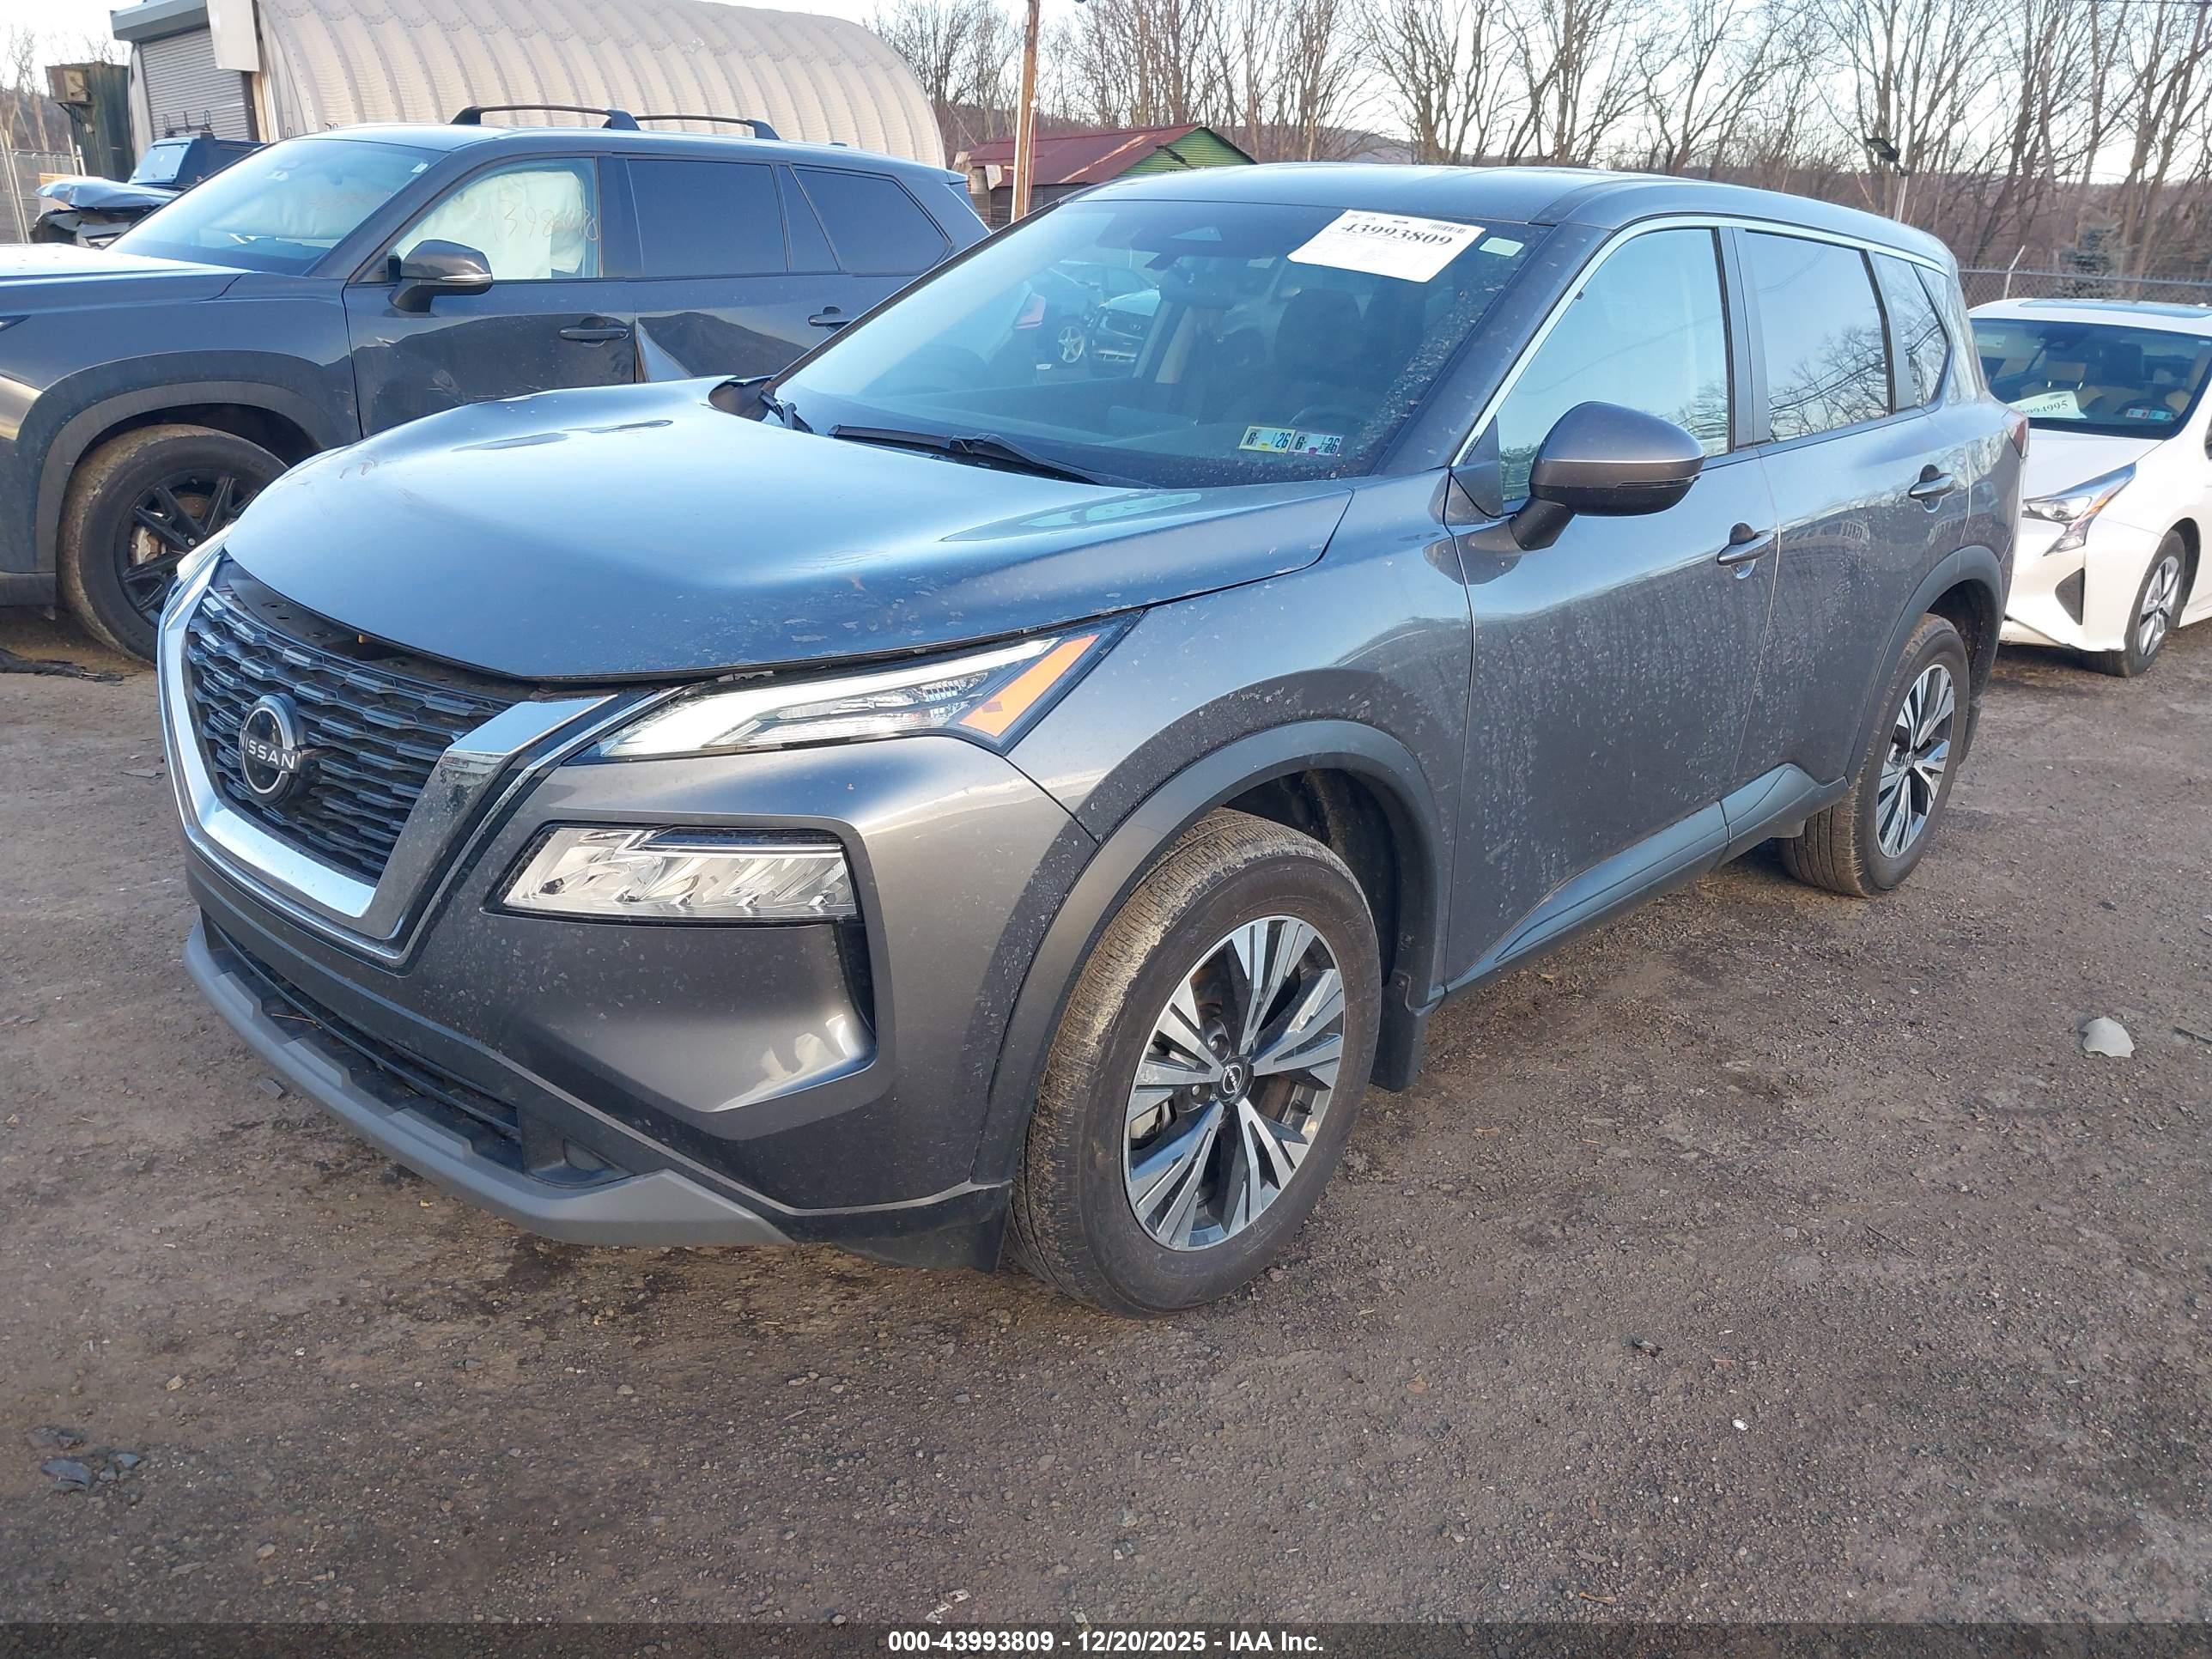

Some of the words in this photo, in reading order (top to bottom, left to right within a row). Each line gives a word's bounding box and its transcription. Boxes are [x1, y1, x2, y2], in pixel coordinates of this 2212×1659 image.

[1340, 222, 1453, 246] 43993809
[2021, 399, 2069, 414] 94995
[1275, 432, 1291, 448] 26
[239, 732, 295, 769] NISSAN
